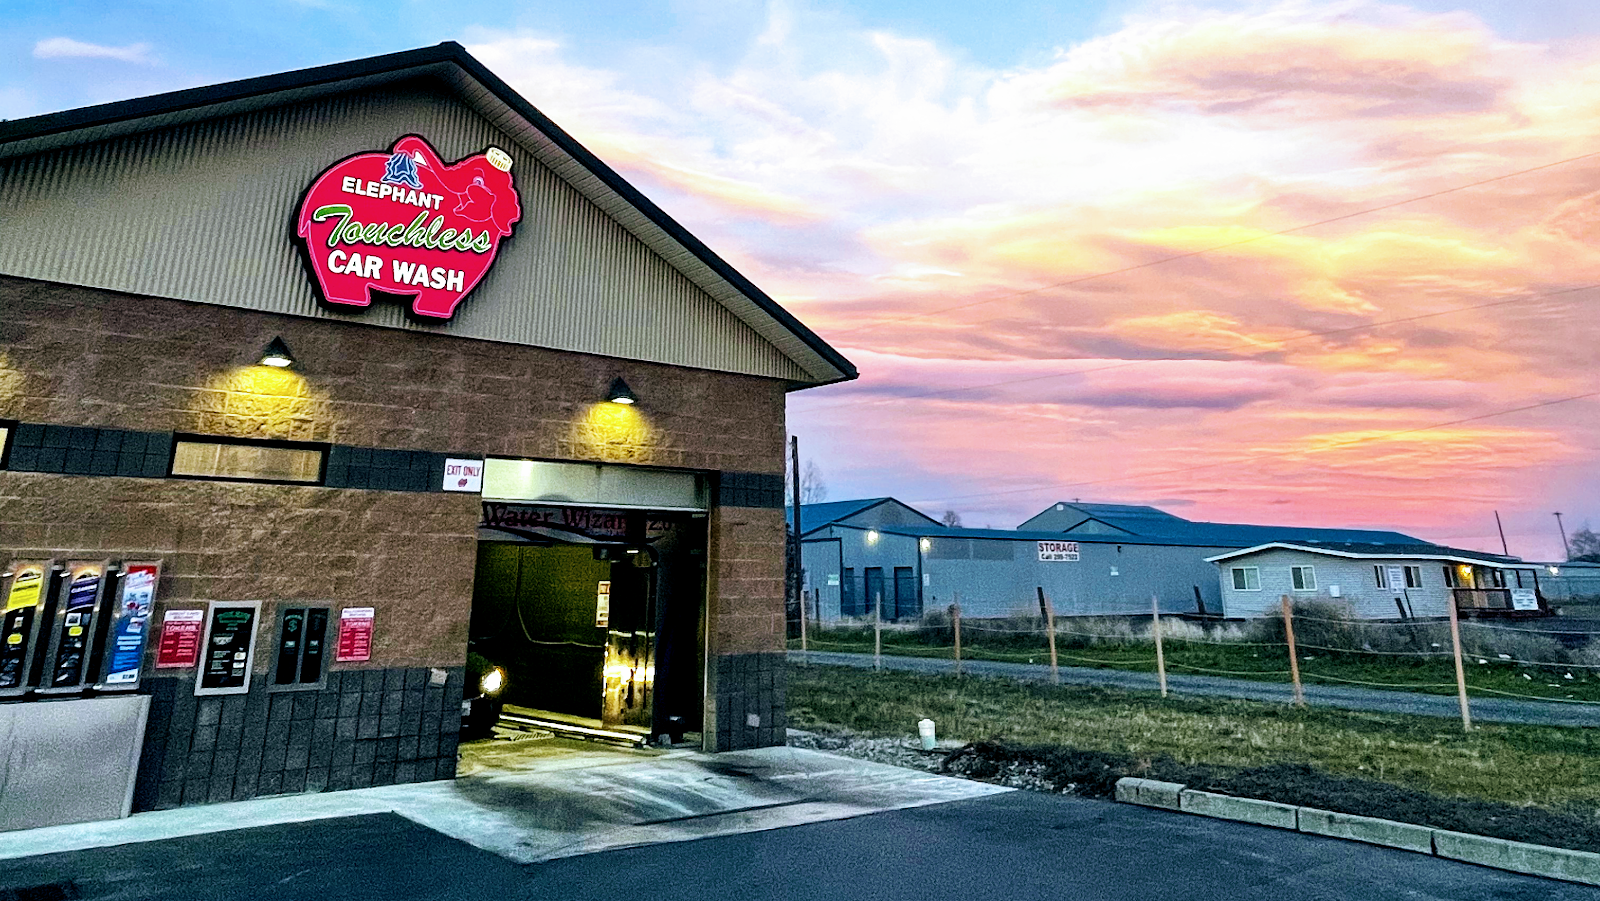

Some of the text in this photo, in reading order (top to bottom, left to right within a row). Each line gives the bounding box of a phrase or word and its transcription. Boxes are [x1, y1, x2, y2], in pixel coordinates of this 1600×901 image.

[341, 176, 444, 210] ELEPHANT
[313, 204, 492, 253] Touchless
[327, 249, 465, 293] CAR WASH
[447, 465, 481, 477] EXIT ONLY
[483, 504, 553, 527] Water
[562, 507, 629, 530] Wizar
[1038, 543, 1079, 553] STORAGE
